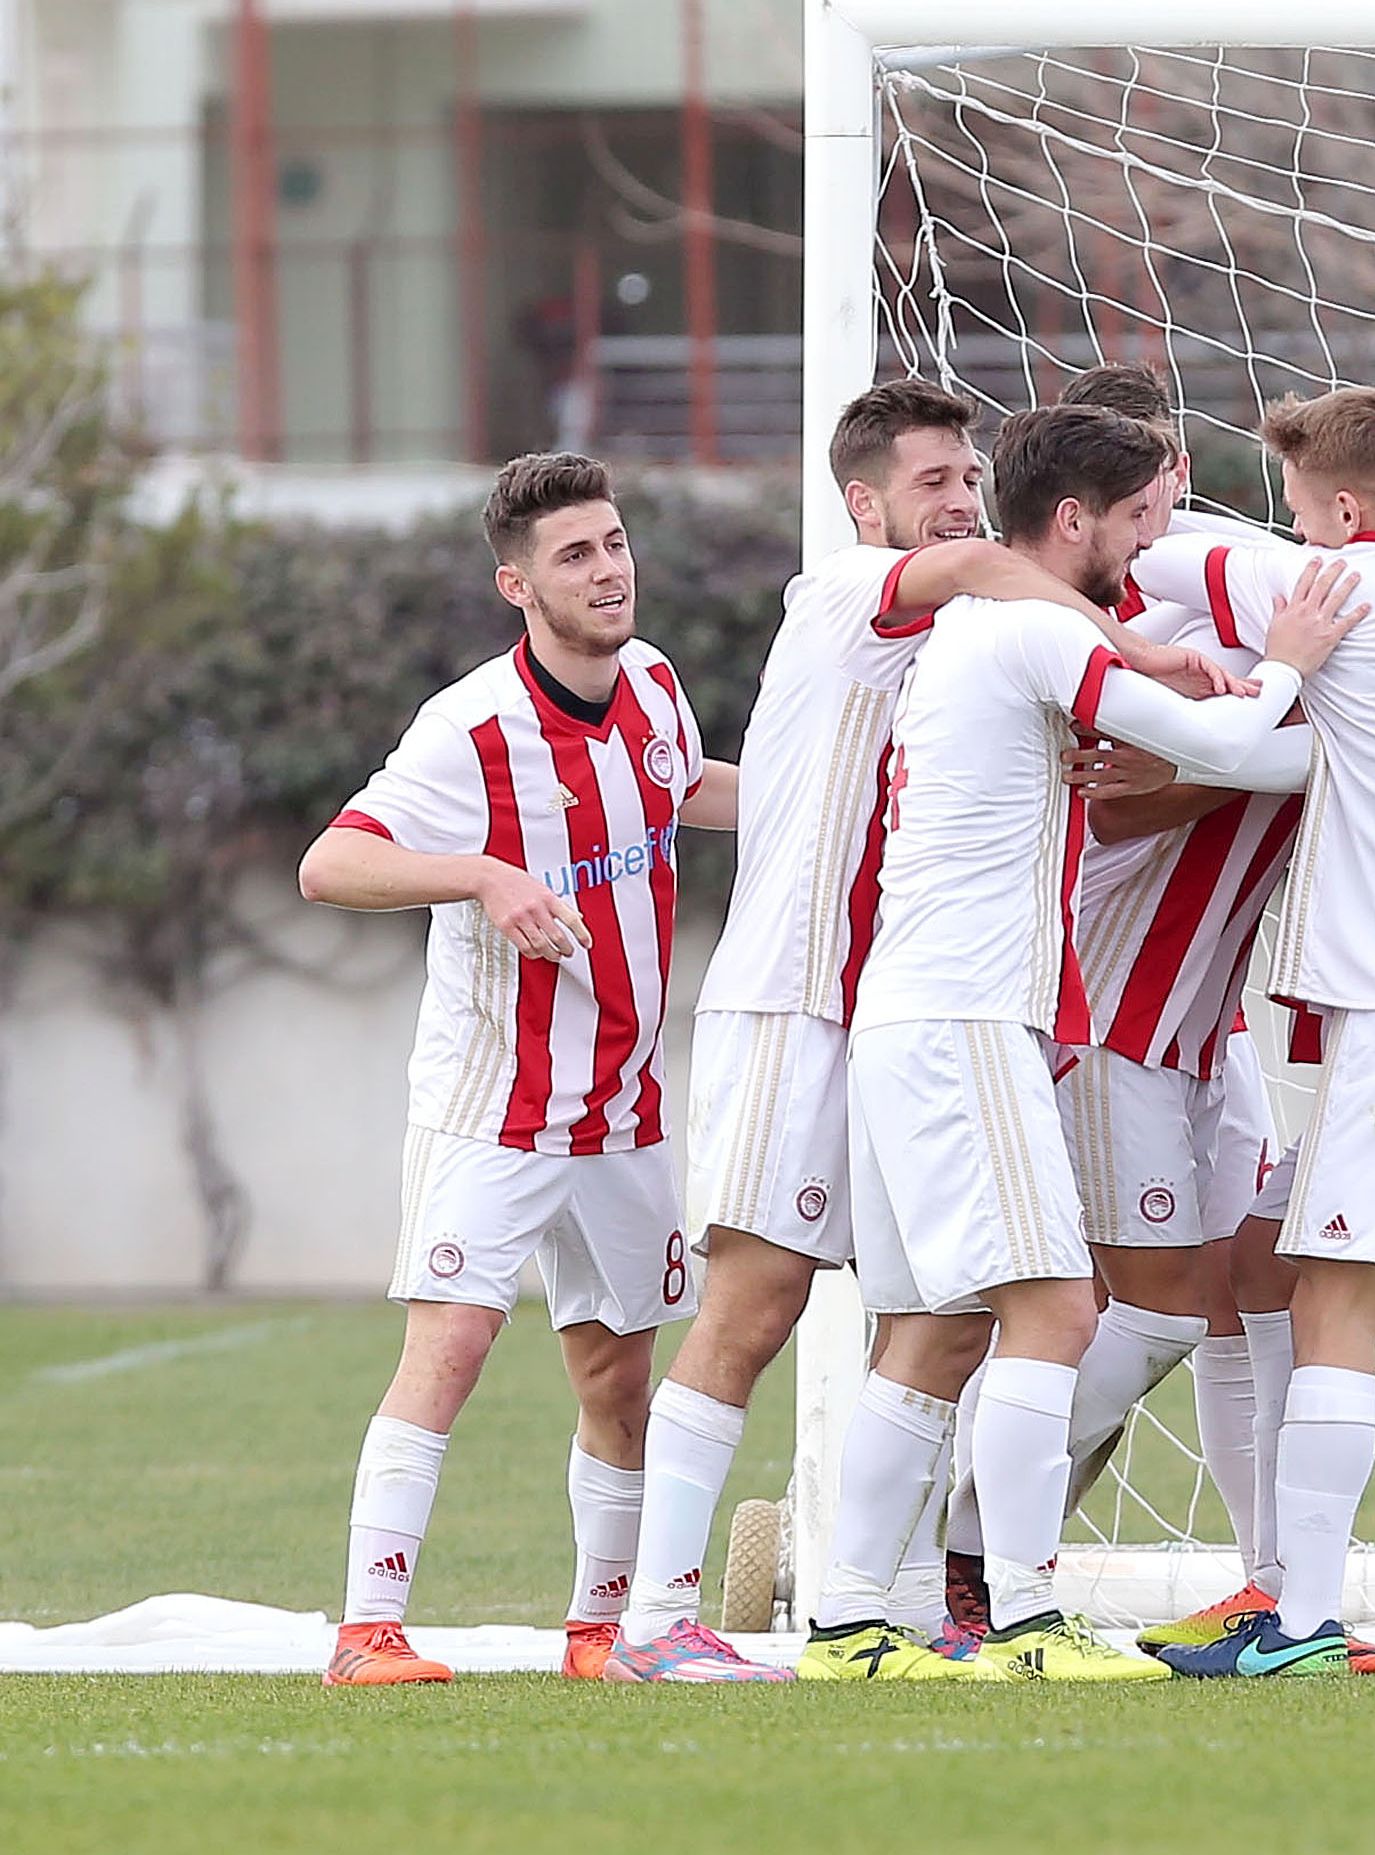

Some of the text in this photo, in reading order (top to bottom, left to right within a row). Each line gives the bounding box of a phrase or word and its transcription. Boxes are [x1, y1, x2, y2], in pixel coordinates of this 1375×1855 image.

[545, 826, 657, 898] unicef
[1319, 1230, 1351, 1240] adidas
[663, 1229, 687, 1306] 8
[368, 1566, 410, 1583] adidas
